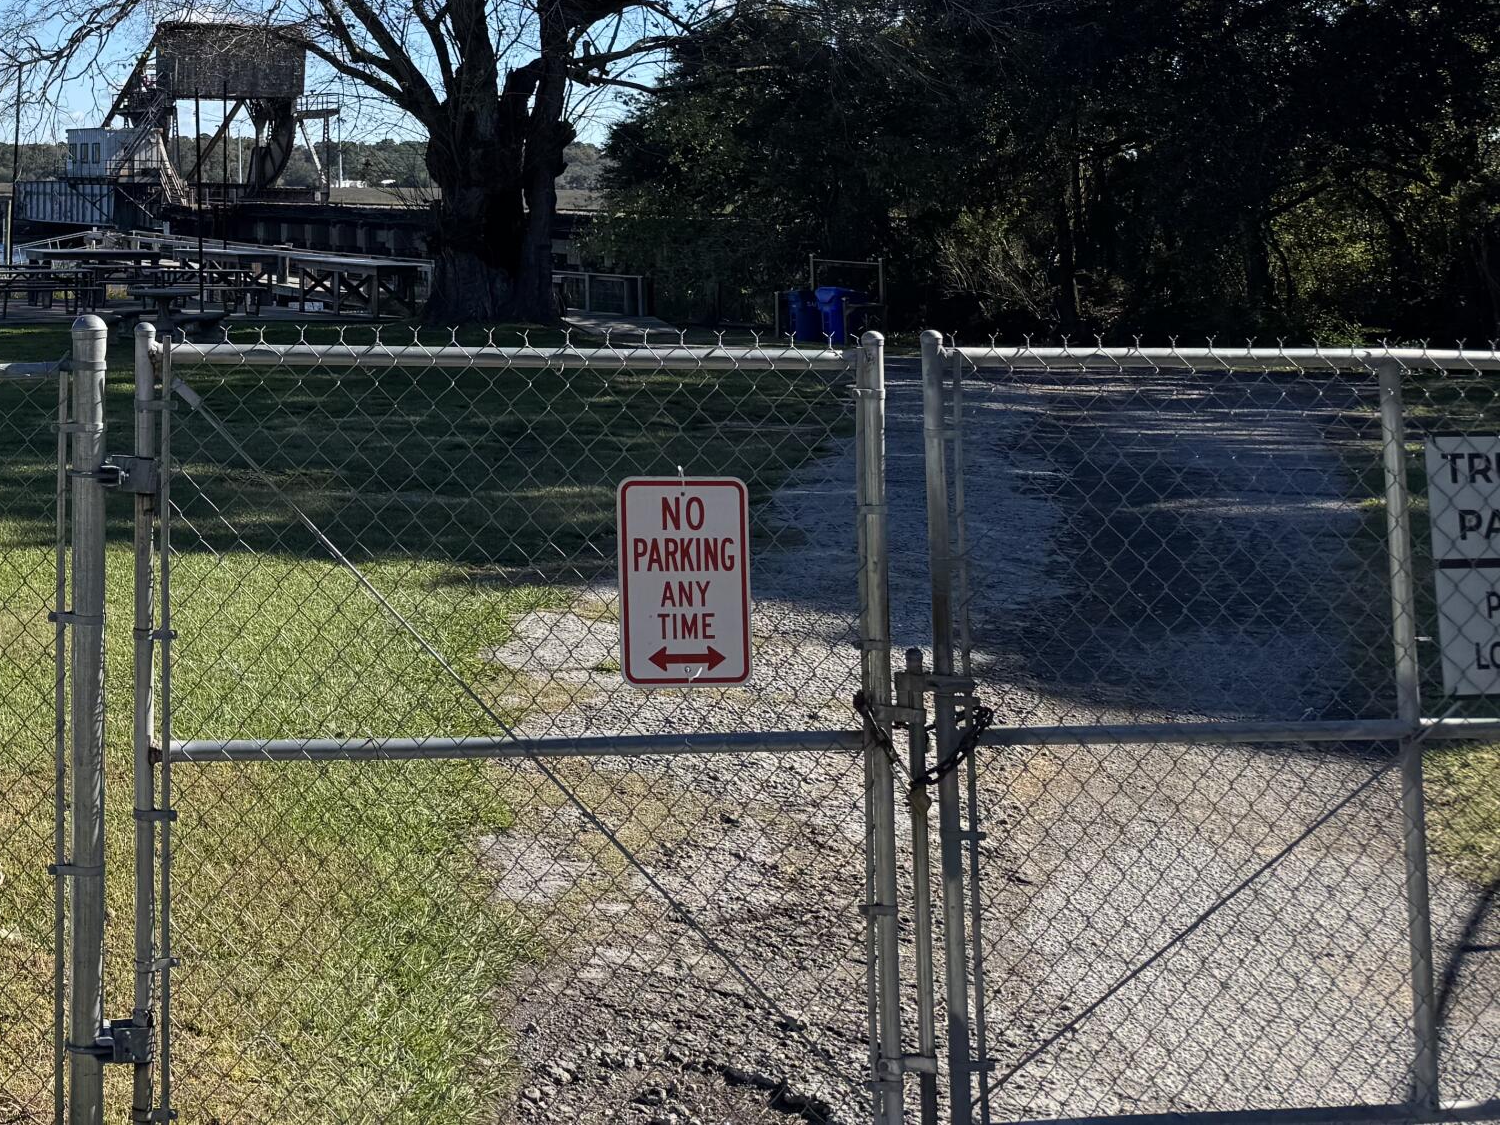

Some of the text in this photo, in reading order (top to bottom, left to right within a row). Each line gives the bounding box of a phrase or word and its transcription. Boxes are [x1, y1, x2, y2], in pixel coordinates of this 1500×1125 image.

[1441, 452, 1500, 484] TR
[661, 496, 705, 531] NO
[633, 537, 735, 572] PARKING
[661, 580, 711, 607] ANY
[657, 613, 716, 640] TIME
